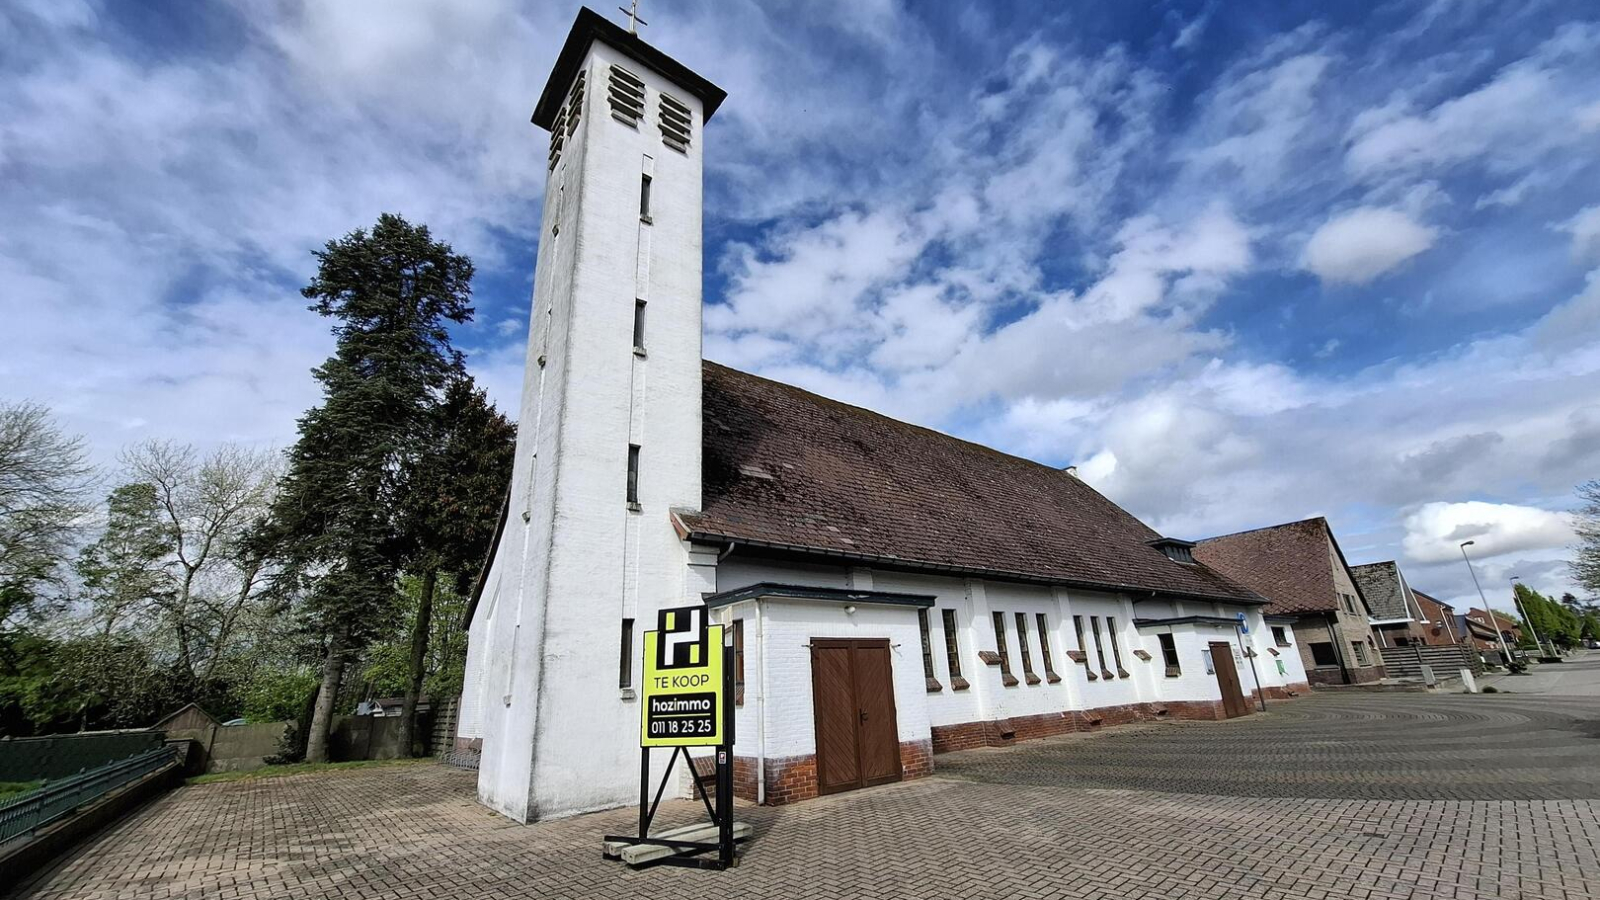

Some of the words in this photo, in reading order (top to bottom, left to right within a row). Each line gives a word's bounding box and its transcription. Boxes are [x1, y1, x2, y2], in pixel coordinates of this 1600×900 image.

[654, 677, 669, 689] TE
[672, 674, 709, 688] KOOP
[652, 698, 711, 712] hozimmo
[651, 721, 665, 733] 011
[668, 721, 678, 733] 18
[681, 720, 694, 733] 25
[698, 719, 711, 732] 25
